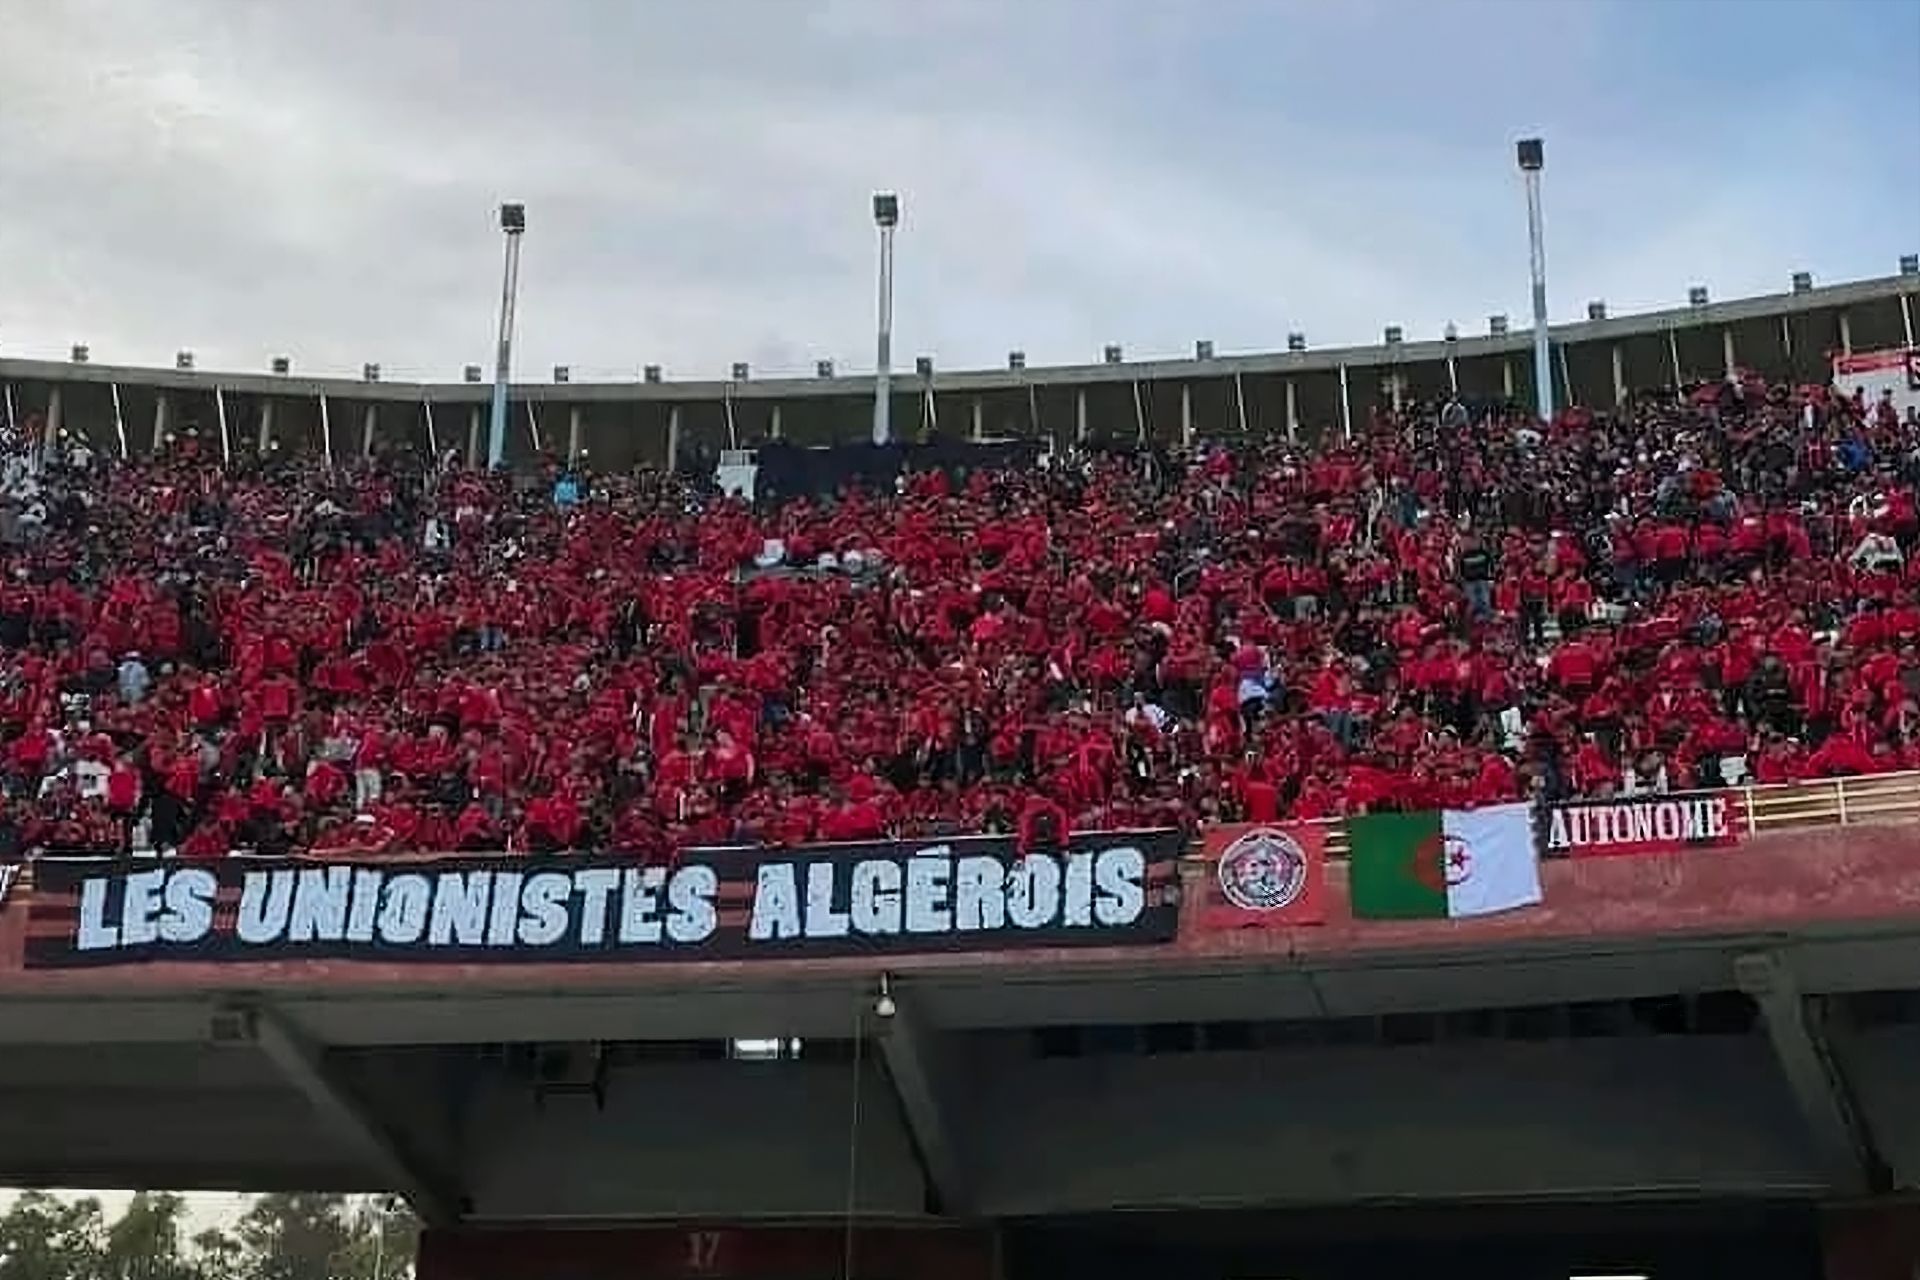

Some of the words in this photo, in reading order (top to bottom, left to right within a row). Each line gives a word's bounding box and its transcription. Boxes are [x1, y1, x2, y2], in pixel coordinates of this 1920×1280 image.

[1548, 798, 1729, 848] AUTONOME
[78, 868, 218, 950] LES
[236, 866, 717, 944] UNIONISTES
[749, 845, 1146, 939] ALGÉROIS
